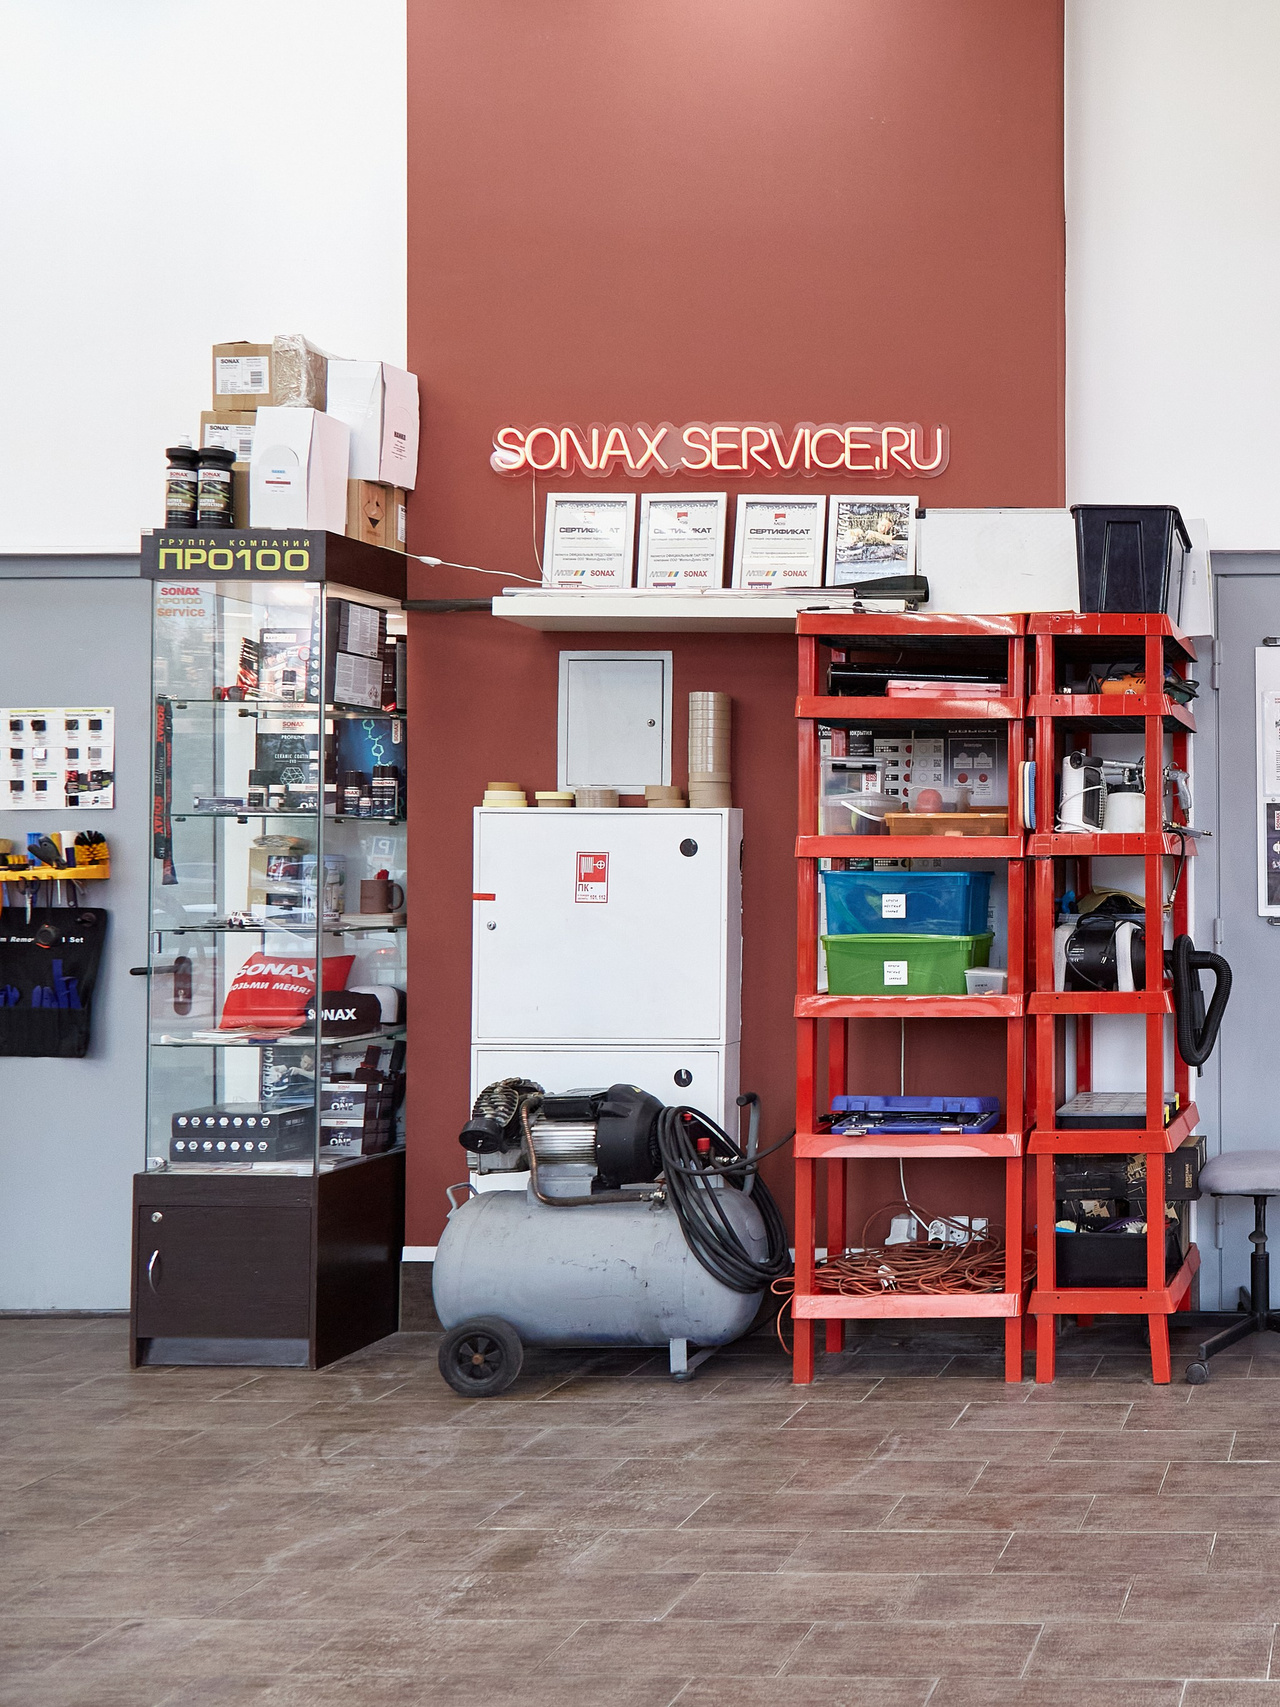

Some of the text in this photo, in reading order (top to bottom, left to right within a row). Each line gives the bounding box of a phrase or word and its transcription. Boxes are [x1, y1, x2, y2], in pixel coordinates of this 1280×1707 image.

[494, 426, 671, 471] SONAX
[229, 539, 310, 547] КОМПАНИЙ
[158, 548, 310, 571] ПРО100
[161, 587, 200, 595] SONAX
[157, 606, 206, 617] service
[157, 705, 165, 743] SONAX
[236, 963, 317, 982] SONAX
[272, 982, 311, 995] МЕНЯ!
[331, 1102, 354, 1111] ONE
[329, 1138, 351, 1147] ONE
